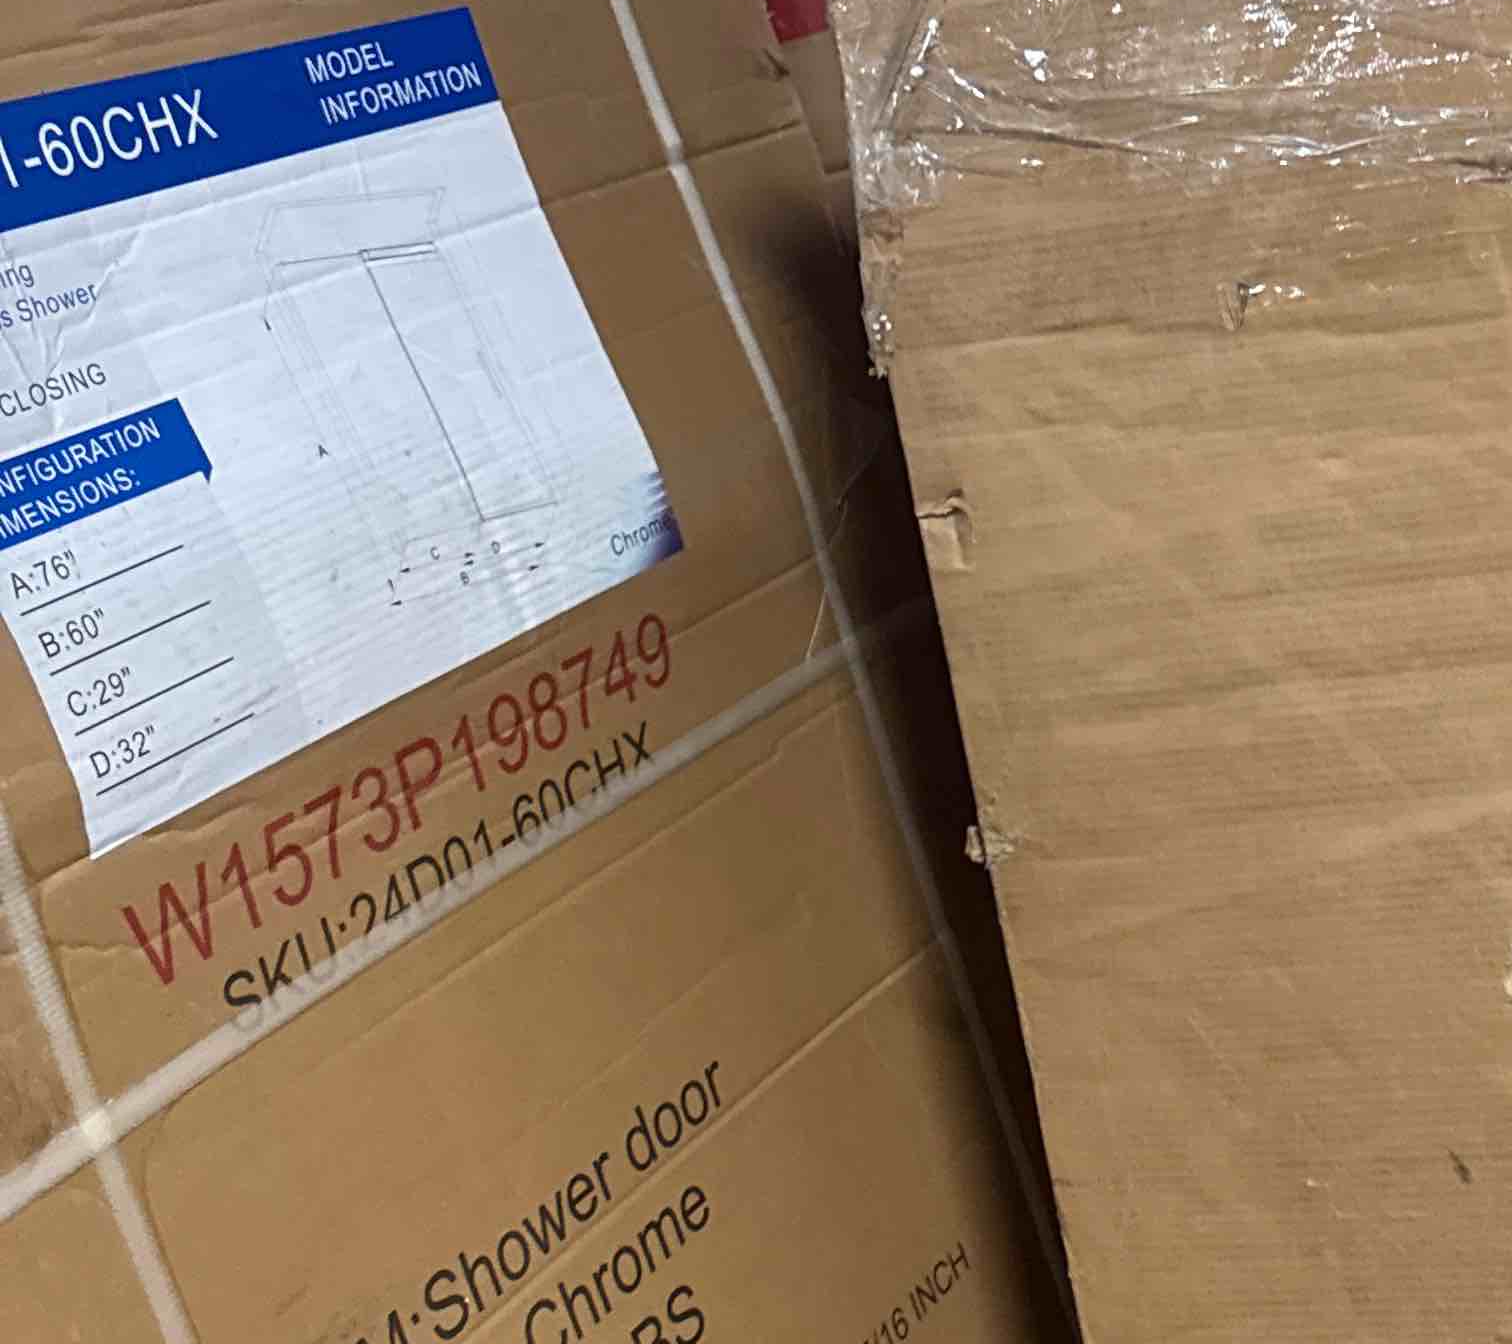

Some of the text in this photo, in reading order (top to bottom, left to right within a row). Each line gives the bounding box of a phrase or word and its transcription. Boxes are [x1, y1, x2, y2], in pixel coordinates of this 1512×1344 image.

[304, 41, 395, 84] MODEL
[319, 62, 483, 126] INFORMATION
[16, 283, 97, 322] Shower
[122, 613, 672, 985] W1573P198749
[625, 1060, 722, 1172] door
[909, 1241, 973, 1323] INCH
